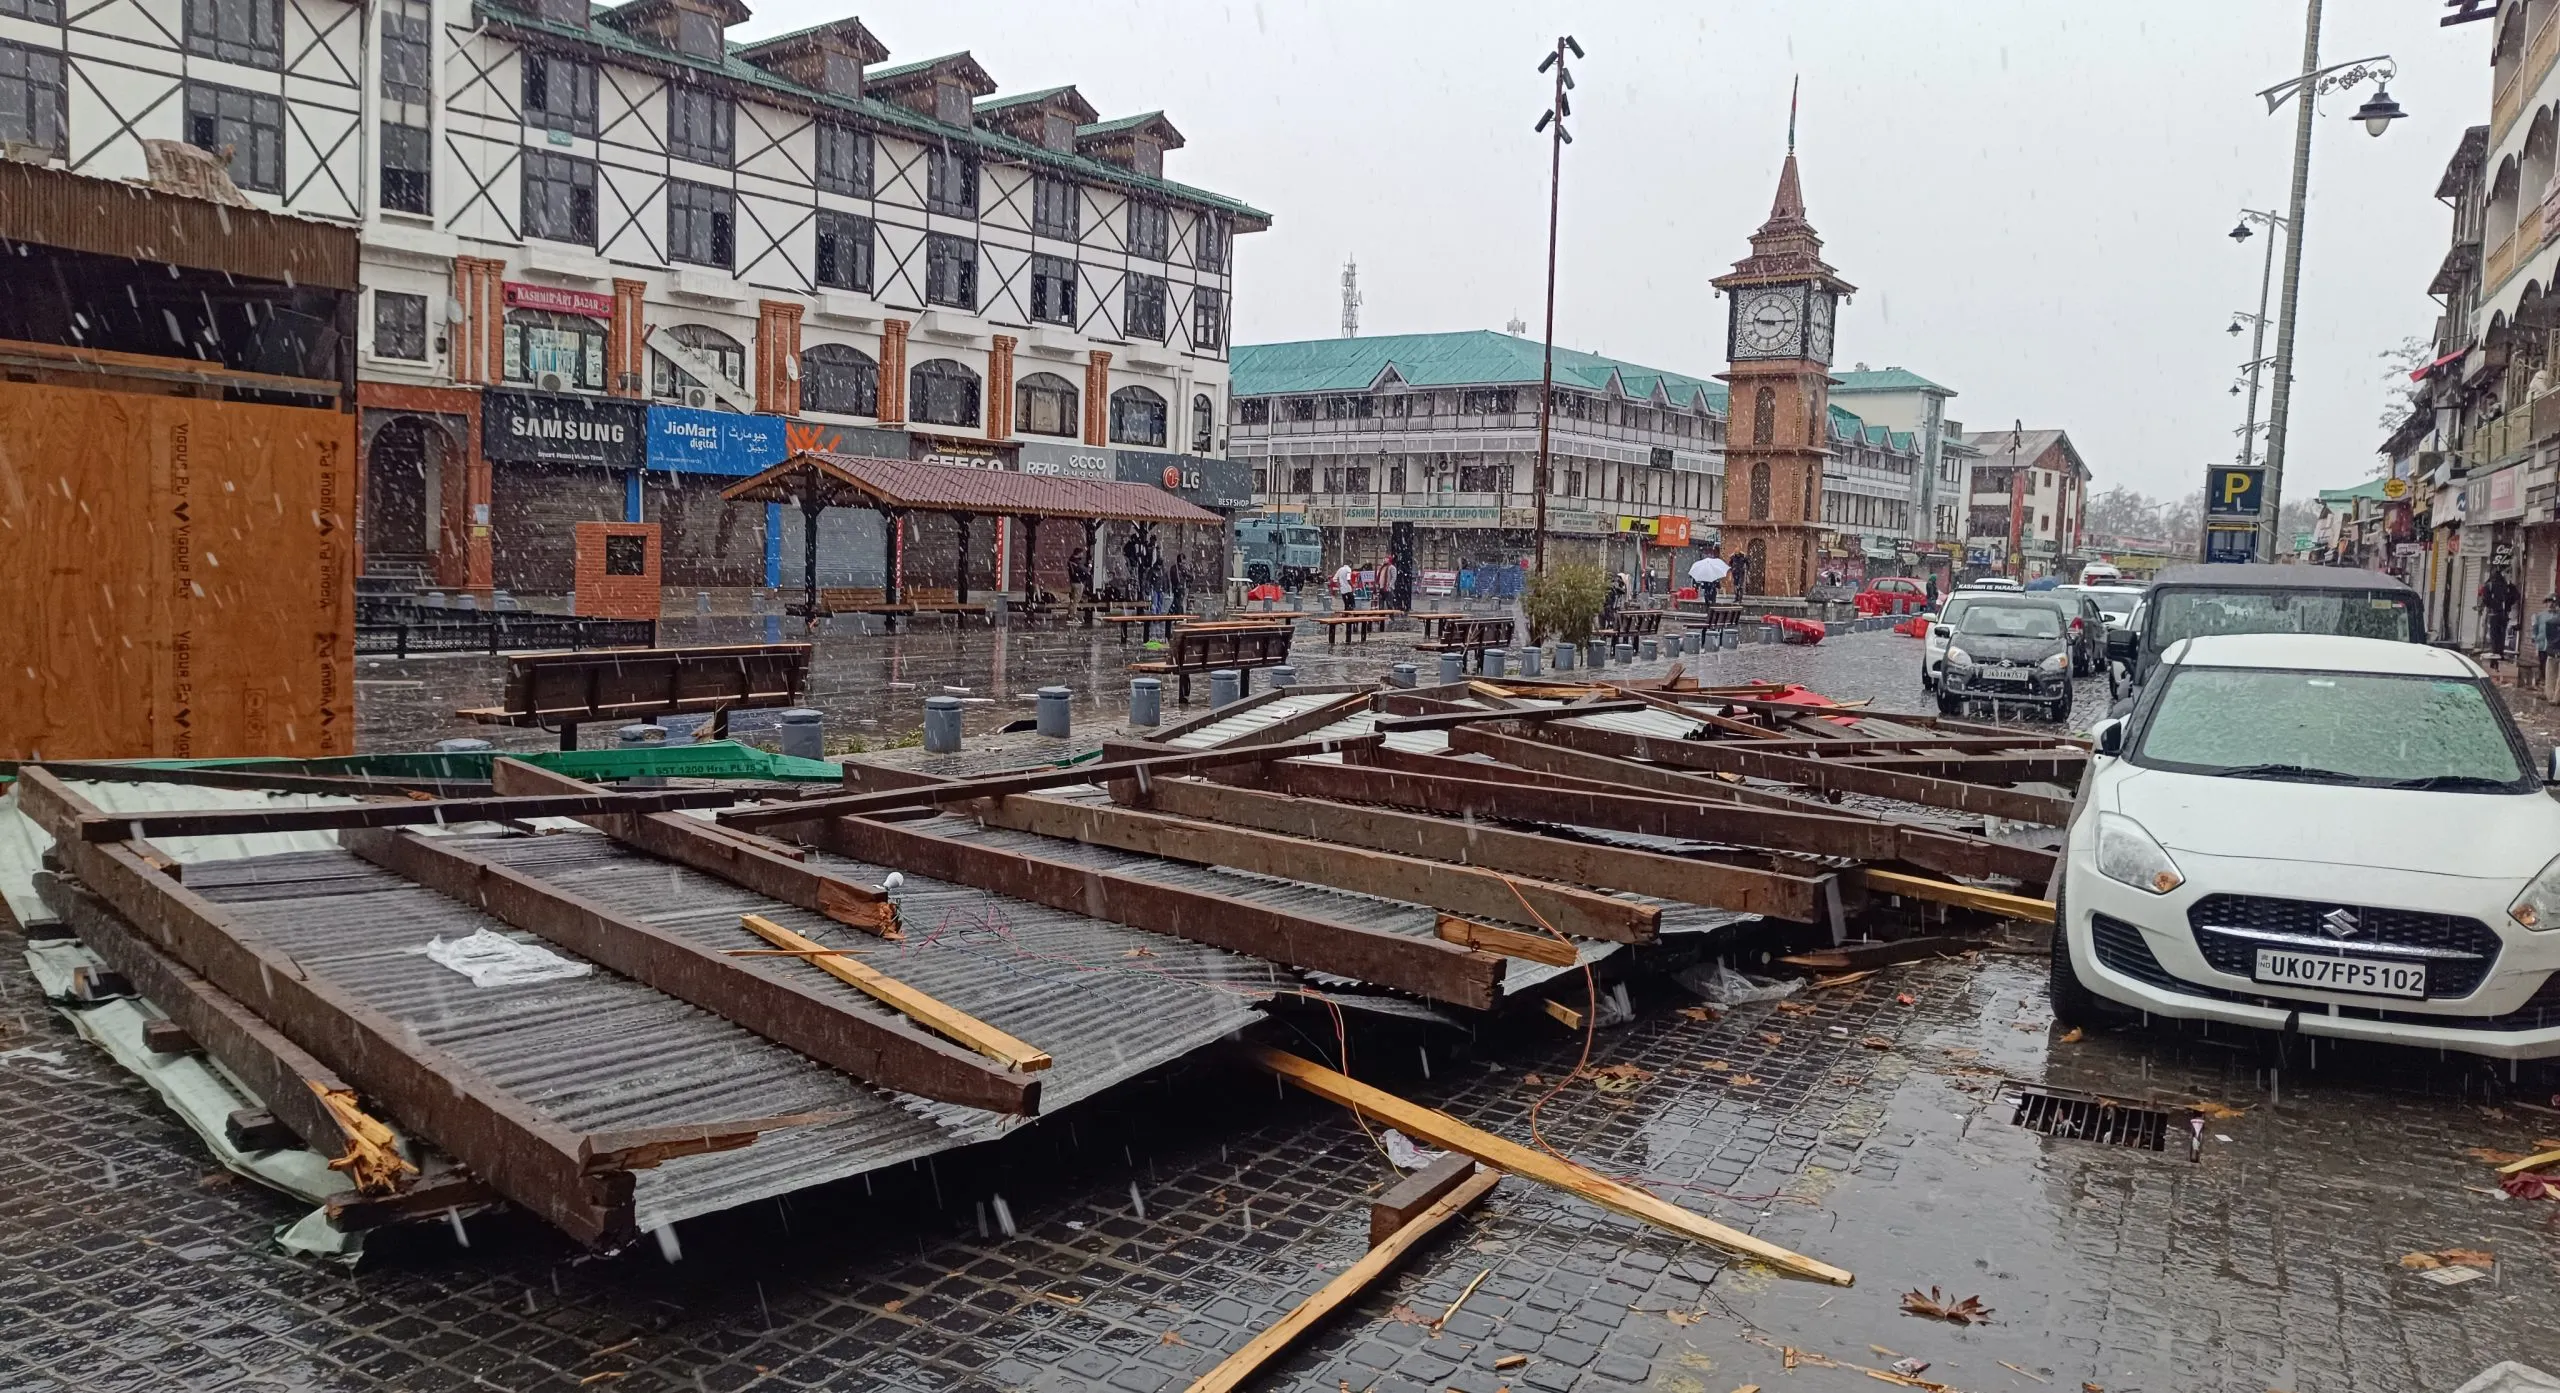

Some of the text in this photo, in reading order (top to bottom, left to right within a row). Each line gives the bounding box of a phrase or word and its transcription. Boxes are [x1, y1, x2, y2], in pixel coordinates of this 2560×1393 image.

[555, 291, 572, 306] ART
[573, 294, 599, 311] BAZAR
[511, 416, 625, 443] SAMSUNG
[663, 421, 718, 439] JioMart
[689, 438, 718, 451] digital
[1068, 453, 1107, 470] ecco
[1181, 470, 1200, 490] LG
[2224, 472, 2251, 504] P
[319, 471, 332, 516] VIGOUR
[1218, 497, 1250, 508] BEST SHOP
[178, 524, 192, 600] VIGOUR PLY
[319, 540, 332, 609] VIGOUR PLY
[177, 630, 192, 678] VIGOUR
[319, 662, 332, 707] VIGOUR
[320, 728, 332, 750] PLY
[679, 764, 704, 775] 1200
[2258, 955, 2424, 992] IND UK07FP5102
